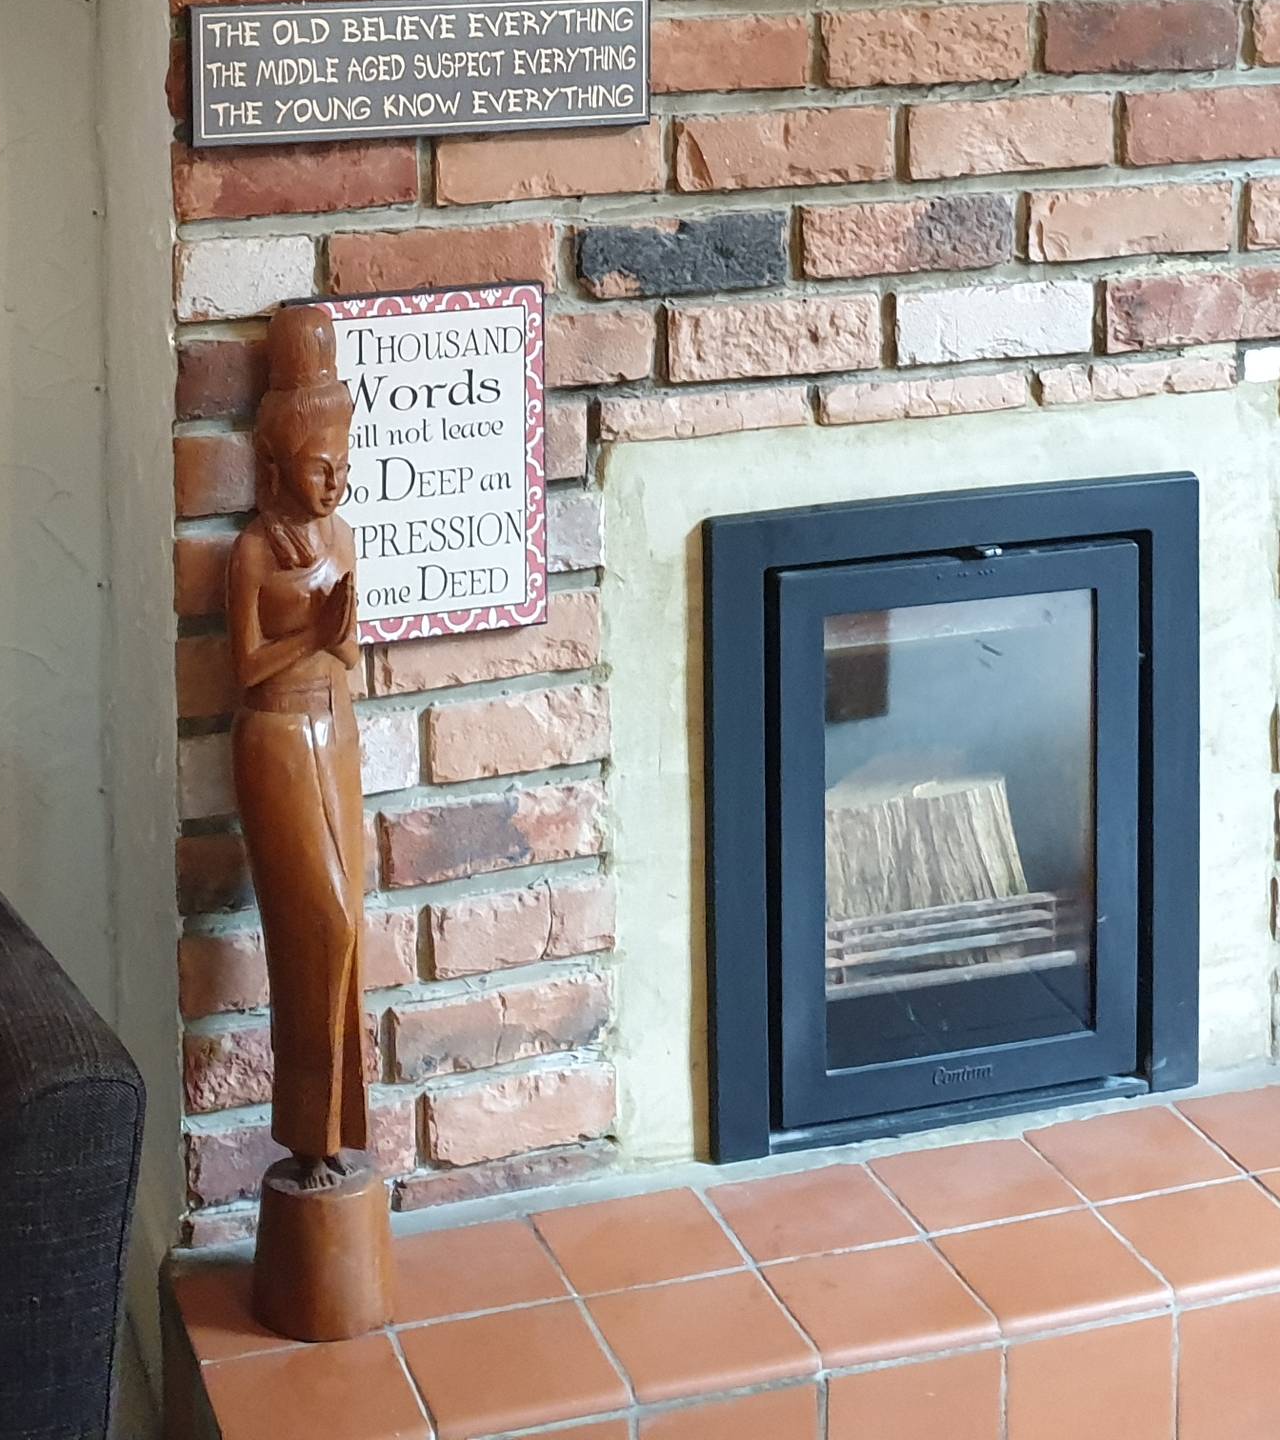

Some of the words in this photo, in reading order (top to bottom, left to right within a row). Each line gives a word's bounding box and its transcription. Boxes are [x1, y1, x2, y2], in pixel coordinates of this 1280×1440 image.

[207, 21, 260, 48] THE
[273, 18, 329, 46] OLD
[342, 14, 455, 44] BELIEVE
[468, 7, 634, 39] EVERYTHING
[207, 61, 246, 89] THE
[256, 57, 338, 86] MIDDLE
[347, 54, 405, 82] AGED
[414, 50, 504, 80] SUSPECT
[514, 45, 636, 76] EVERYTHING
[211, 100, 263, 128] THE
[275, 96, 371, 125] YOUNG
[384, 92, 460, 120] KNOW
[472, 84, 634, 115] EVERYTHING
[347, 326, 523, 366] THOUSAND
[341, 369, 501, 414] Words
[386, 418, 433, 446] not
[442, 418, 504, 440] leave
[376, 456, 473, 501] DEEP
[480, 471, 512, 491] an
[352, 509, 522, 560] PRESSION
[366, 585, 410, 607] one
[417, 564, 509, 602] DEED
